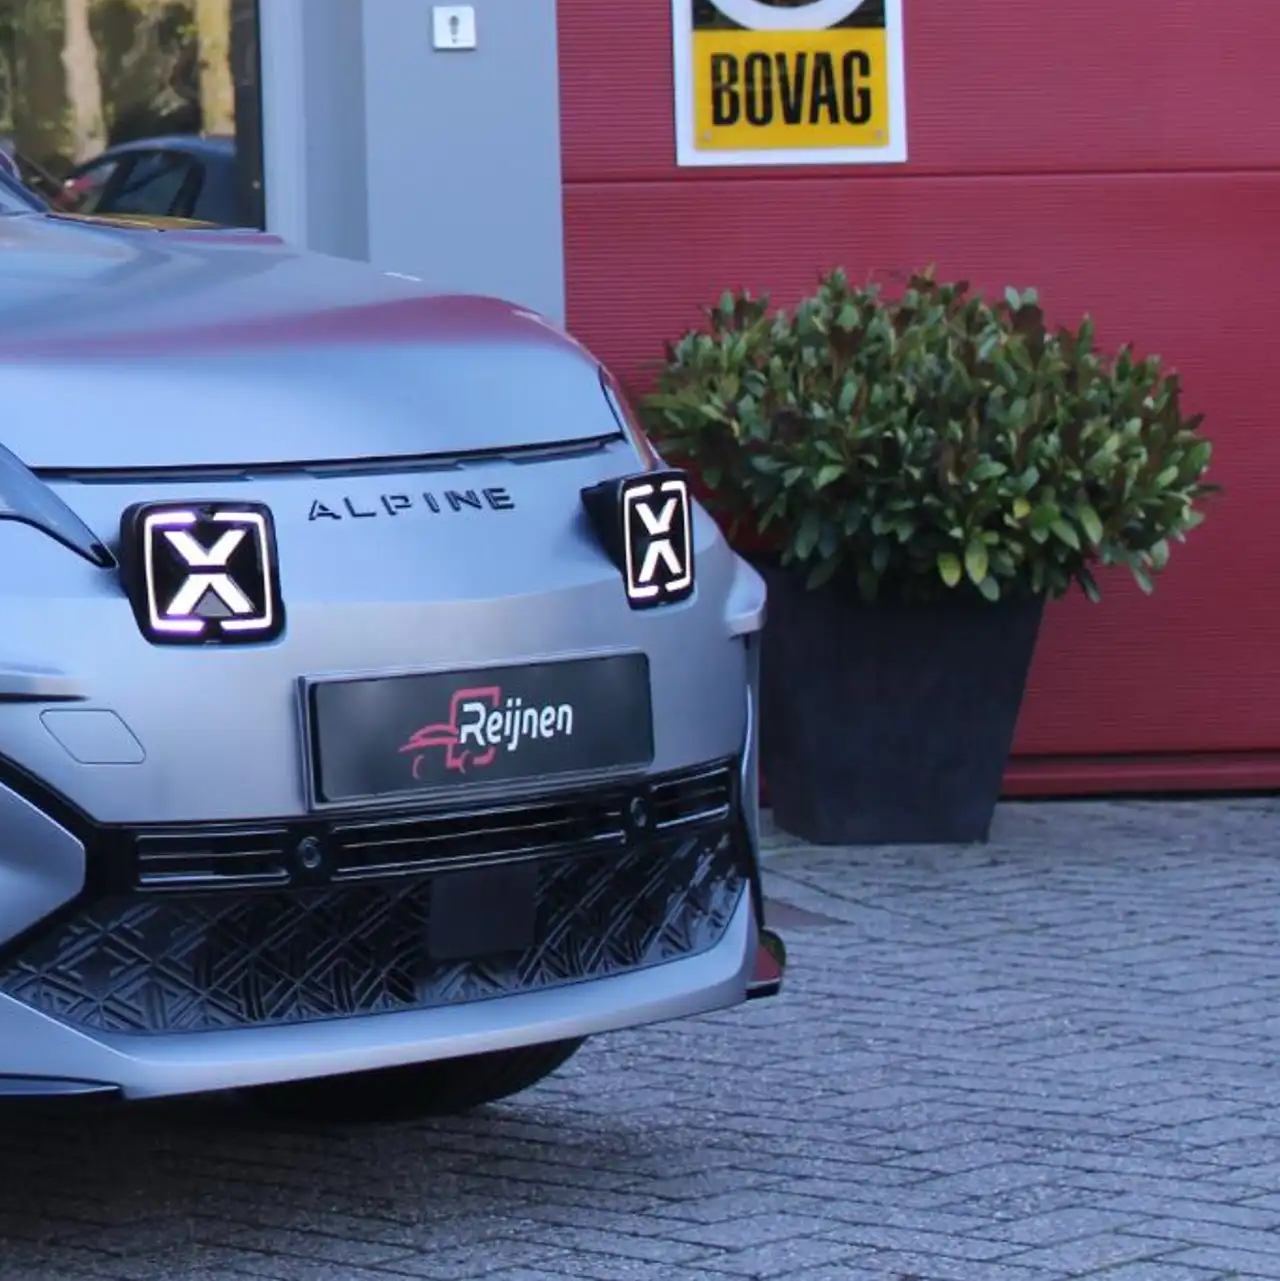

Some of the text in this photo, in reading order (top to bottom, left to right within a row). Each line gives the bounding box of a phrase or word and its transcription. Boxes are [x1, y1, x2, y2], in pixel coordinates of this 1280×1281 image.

[710, 50, 872, 127] BOVAG
[307, 487, 516, 521] ALPINE
[460, 697, 574, 751] Reijnen
